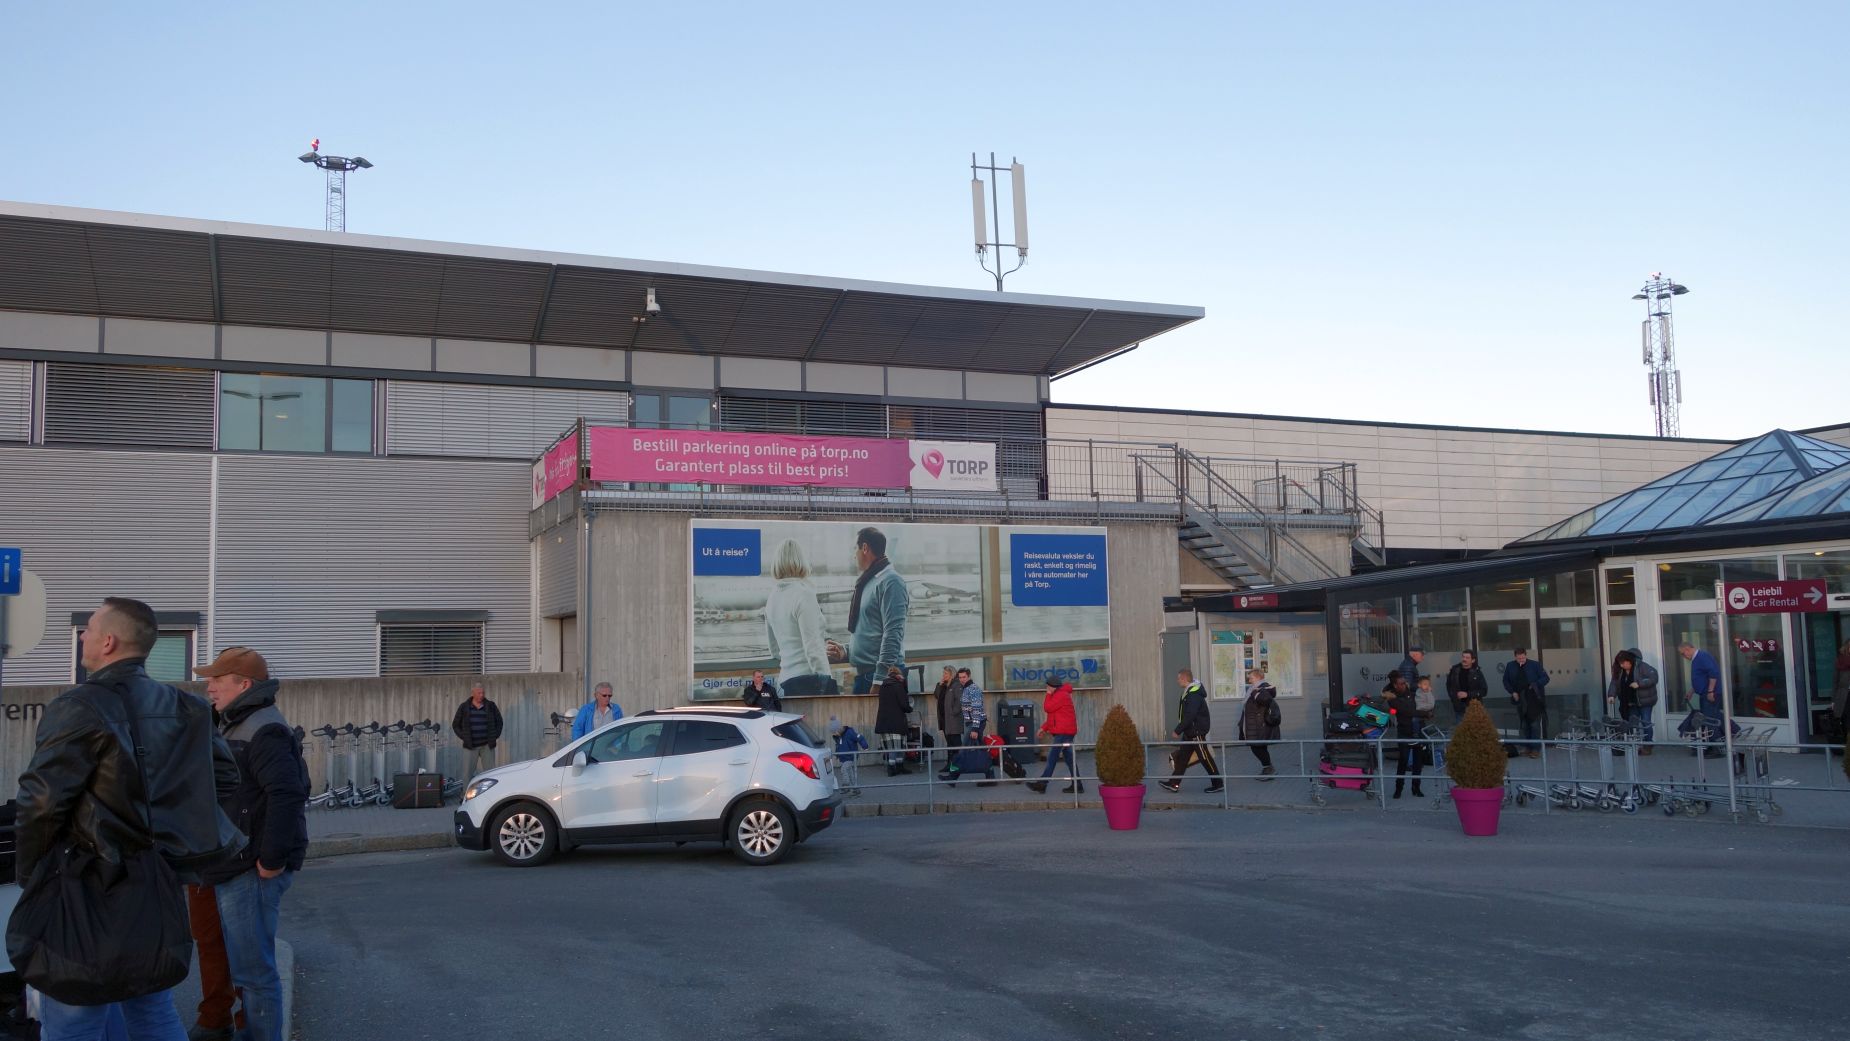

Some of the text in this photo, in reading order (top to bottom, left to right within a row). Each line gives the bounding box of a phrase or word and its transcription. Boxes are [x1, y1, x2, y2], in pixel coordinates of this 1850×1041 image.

[633, 438, 869, 462] Bestill parkering online på torp.no
[655, 458, 850, 478] Garantert plass til best pris!
[947, 460, 988, 474] TORP
[702, 547, 749, 556] Ut å reise?
[1024, 562, 1043, 570] raskt,
[1075, 562, 1097, 571] rimelig
[1024, 581, 1051, 589] på Torp.
[1752, 586, 1782, 596] Leiebil
[1752, 597, 1798, 608] Car Rental
[1012, 666, 1080, 681] Nordea
[702, 678, 723, 689] Gjør
[726, 678, 742, 688] det
